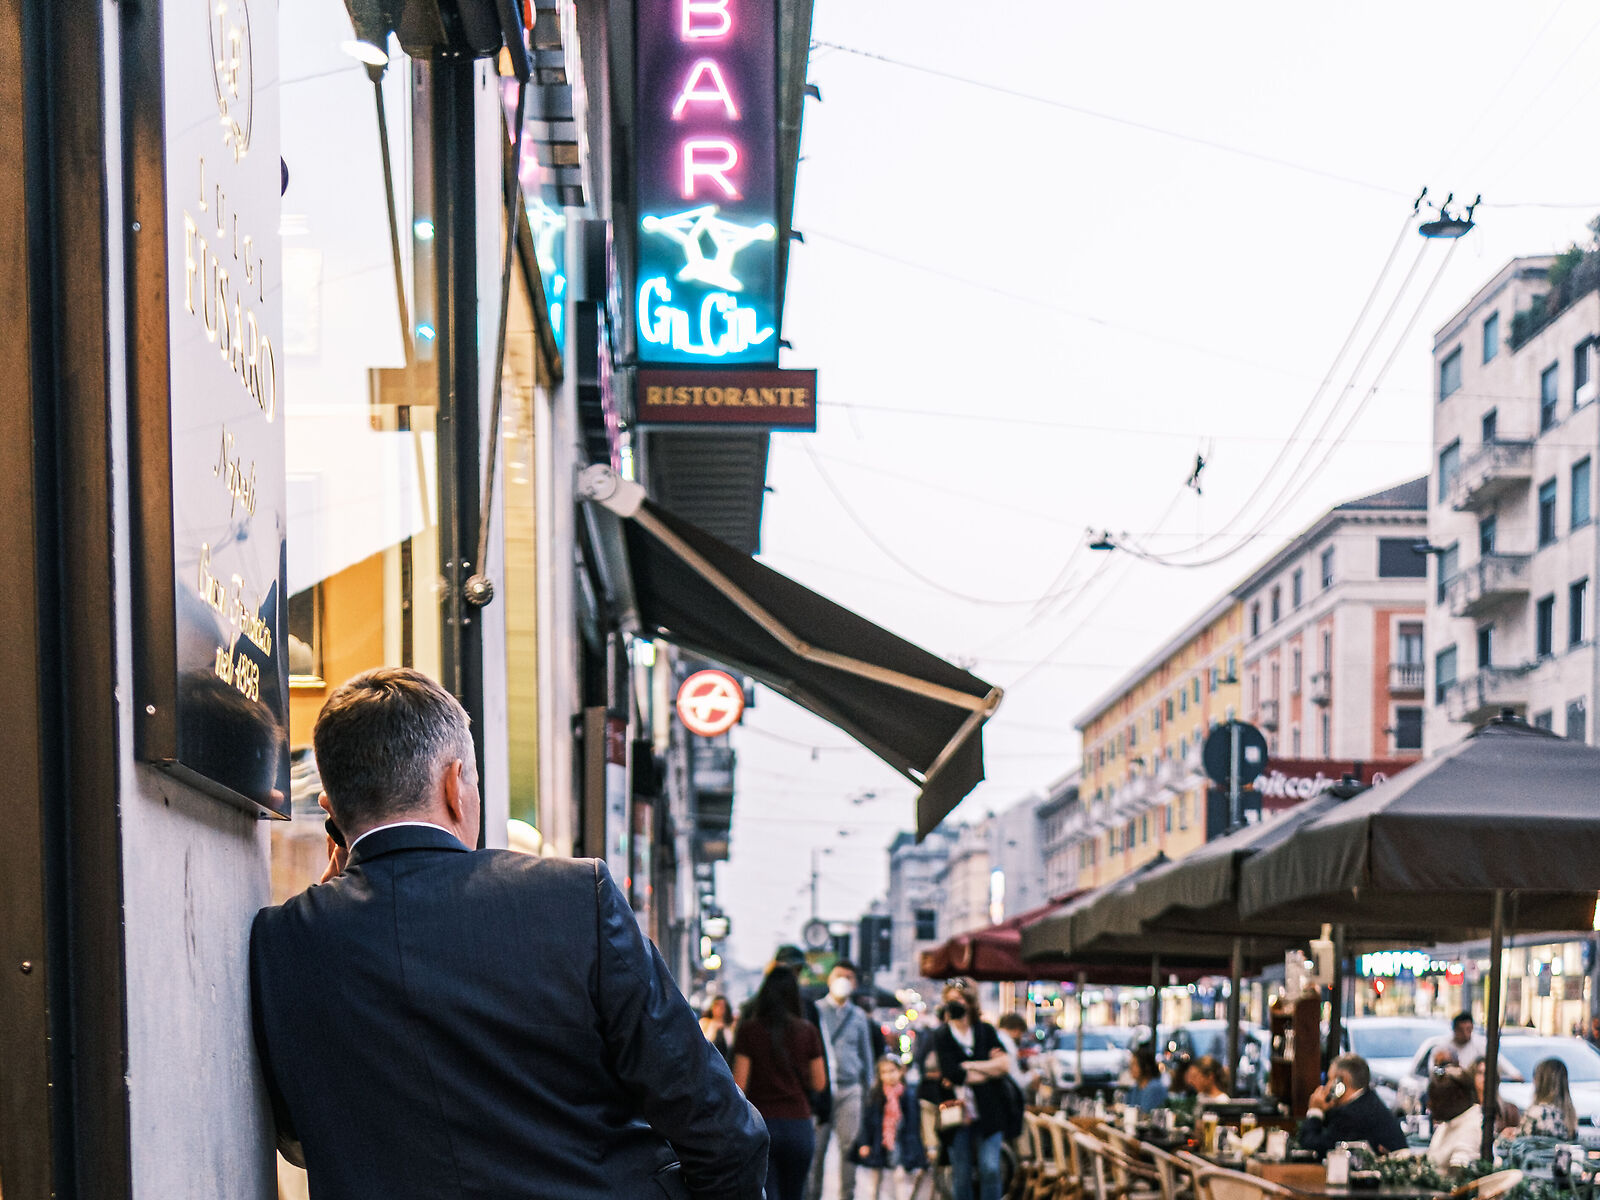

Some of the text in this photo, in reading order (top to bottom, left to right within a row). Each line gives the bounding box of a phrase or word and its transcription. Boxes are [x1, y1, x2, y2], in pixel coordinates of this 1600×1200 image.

[669, 0, 743, 200] BAR
[199, 157, 264, 303] LUIGI
[183, 209, 276, 423] FUSARO
[646, 386, 807, 408] RISTORANTE
[212, 424, 257, 519] Napoli
[235, 652, 260, 703] 1893
